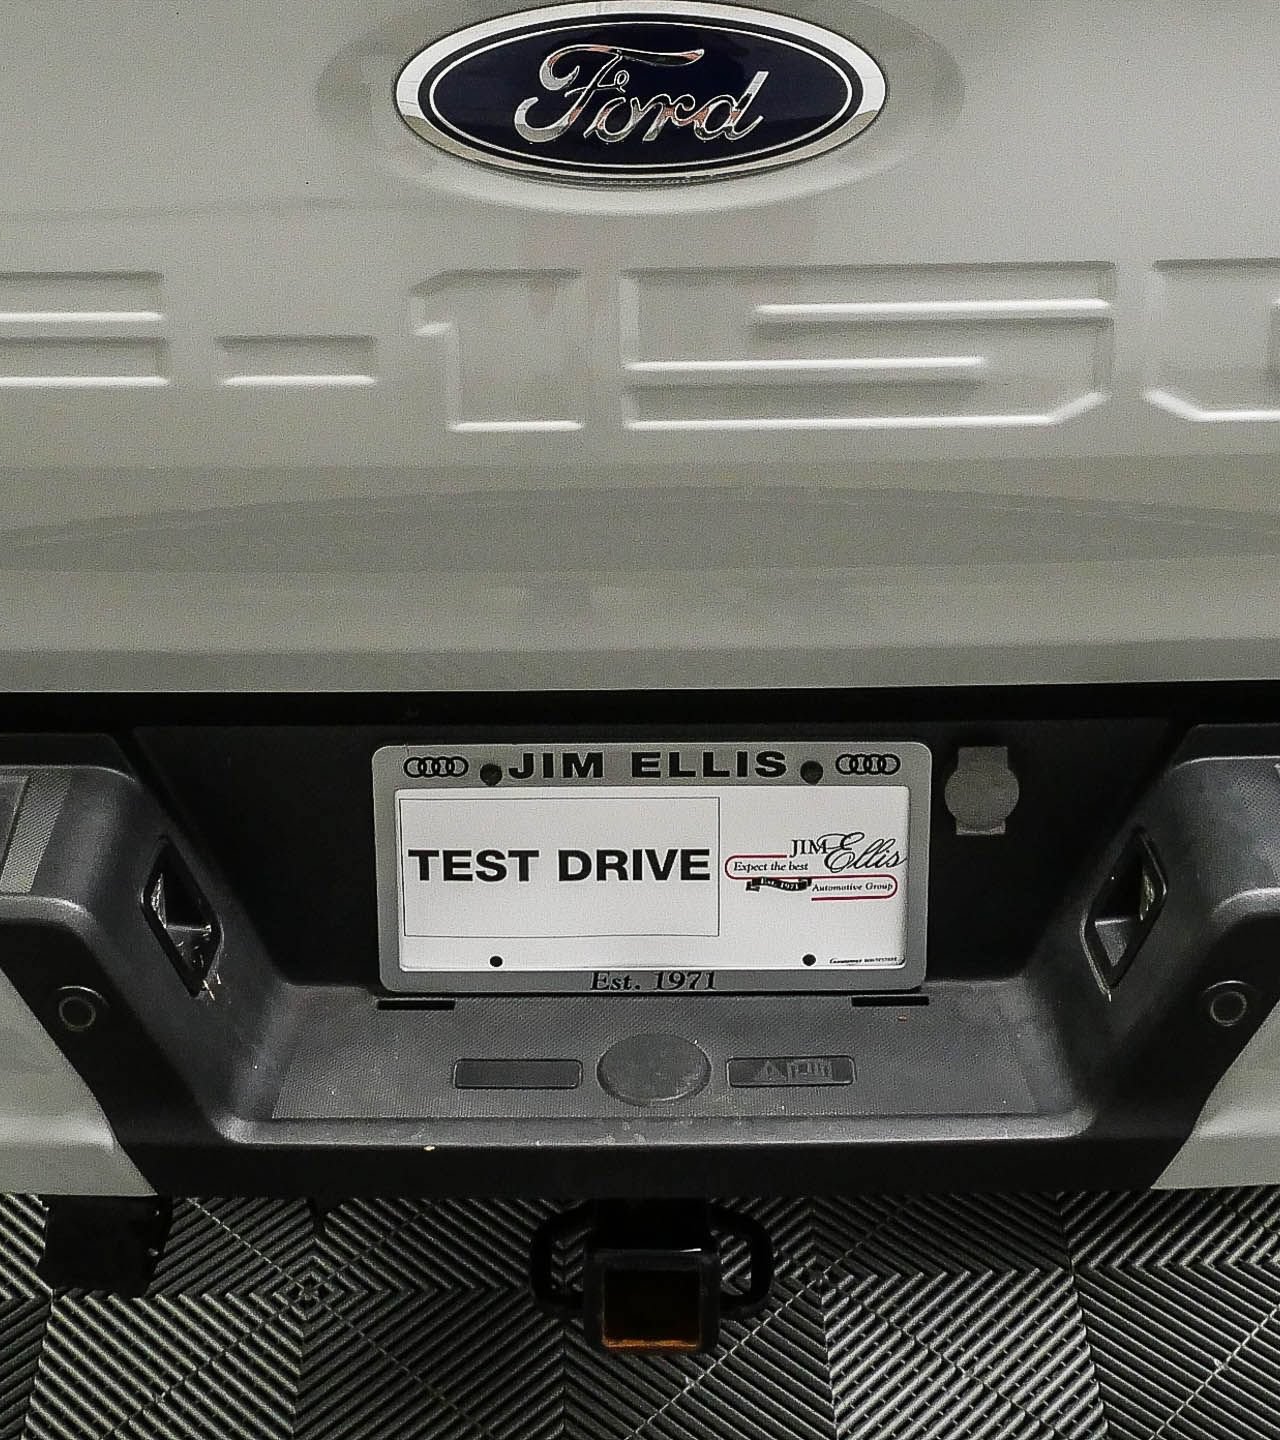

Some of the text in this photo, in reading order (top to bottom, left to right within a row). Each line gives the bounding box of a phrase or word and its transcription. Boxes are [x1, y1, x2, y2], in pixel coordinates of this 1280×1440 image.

[514, 43, 769, 143] Ford
[508, 750, 788, 779] JIM ELLIS
[407, 848, 711, 882] TEST DRIVE
[733, 861, 809, 873] Expect the best
[789, 831, 907, 874] JIM Ellis
[812, 882, 893, 892] Automotive Group
[590, 970, 717, 991] Est. 1971
